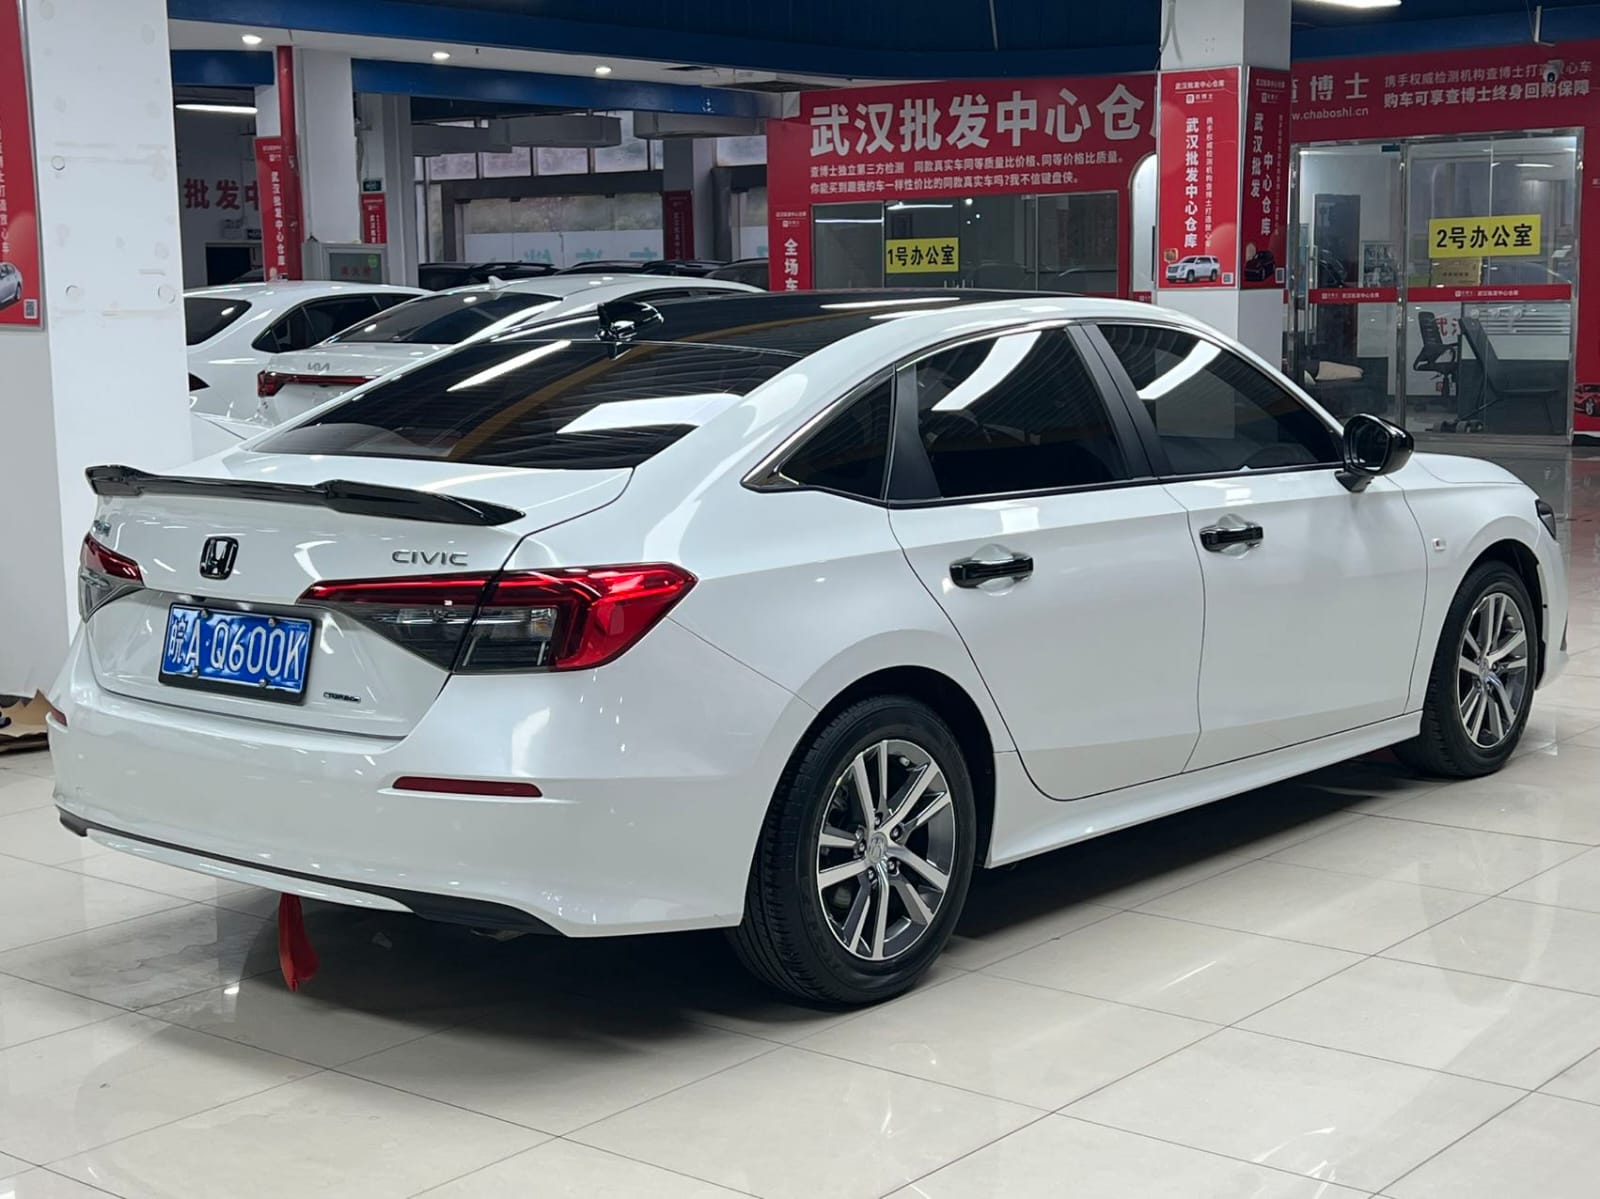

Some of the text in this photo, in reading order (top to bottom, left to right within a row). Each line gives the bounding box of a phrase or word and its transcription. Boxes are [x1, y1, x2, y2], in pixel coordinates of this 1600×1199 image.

[1384, 79, 1590, 108] 购车可享查博士终身回购保障
[810, 83, 1156, 158] 武汉批发中心仓
[1250, 113, 1264, 198] 武汉批发
[1184, 117, 1199, 248] 武汉批发中心仓库
[1261, 152, 1273, 236] 中心仓库
[887, 244, 955, 267] 1号办公室
[1436, 223, 1532, 249] 2号办公室
[392, 550, 469, 567] CIVIC
